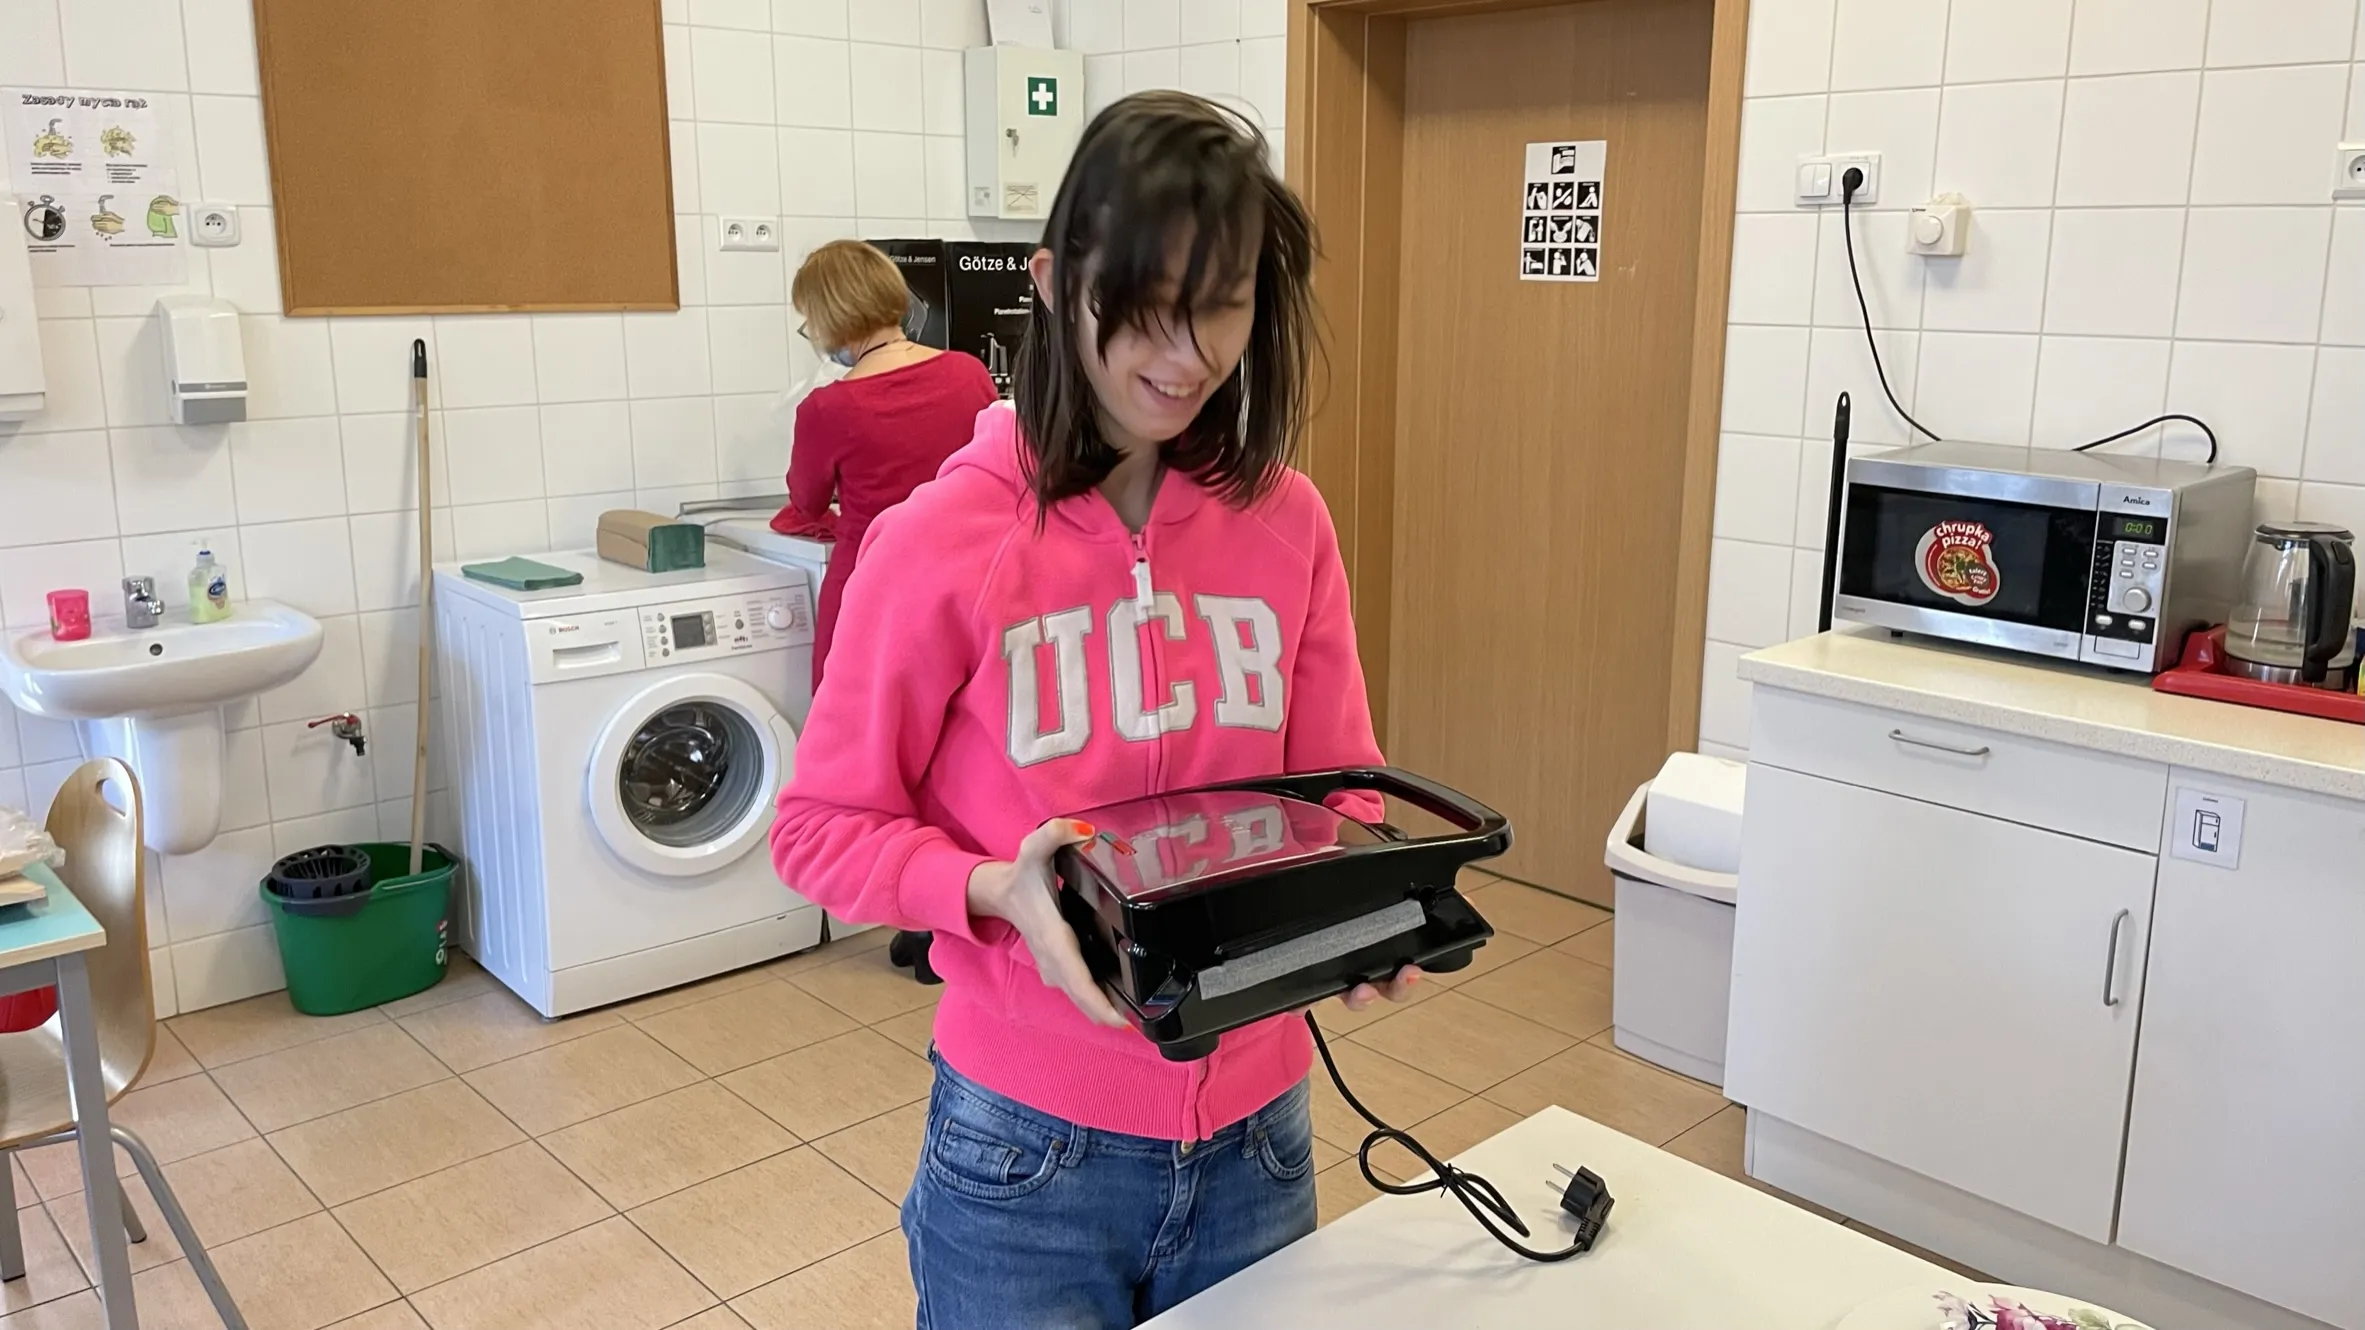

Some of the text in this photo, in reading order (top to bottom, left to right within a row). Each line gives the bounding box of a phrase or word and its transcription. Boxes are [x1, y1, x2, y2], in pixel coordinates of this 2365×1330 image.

[22, 94, 75, 109] Zasady
[914, 255, 936, 264] Jensen
[959, 255, 1004, 271] Götze
[1006, 256, 1017, 271] &
[2123, 495, 2151, 506] Amica
[1936, 520, 1990, 543] chrupka
[2125, 522, 2153, 535] 0:00
[1941, 533, 1982, 551] pizza!
[1000, 591, 1286, 769] UCB
